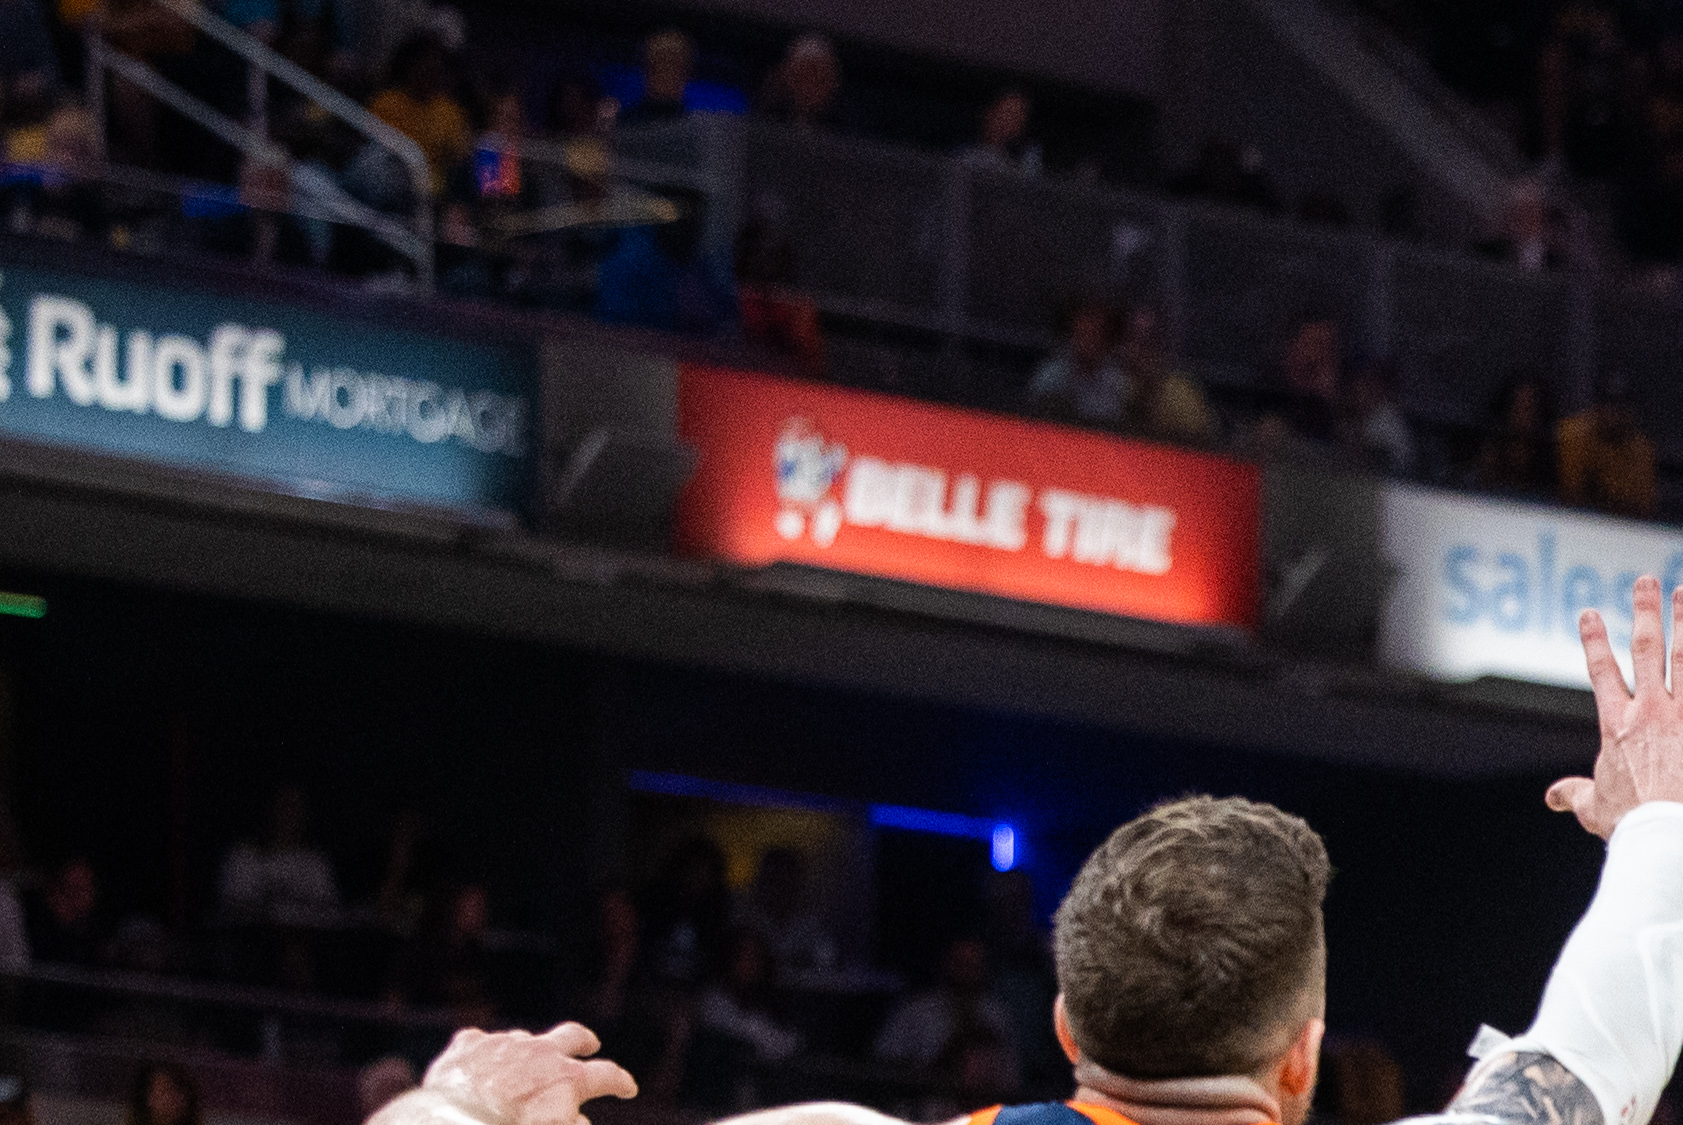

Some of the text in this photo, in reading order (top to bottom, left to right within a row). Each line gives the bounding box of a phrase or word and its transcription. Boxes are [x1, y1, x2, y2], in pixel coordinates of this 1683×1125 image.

[26, 293, 526, 458] Ruoff MORTGAGE
[845, 455, 1176, 577] BELLE TIRE
